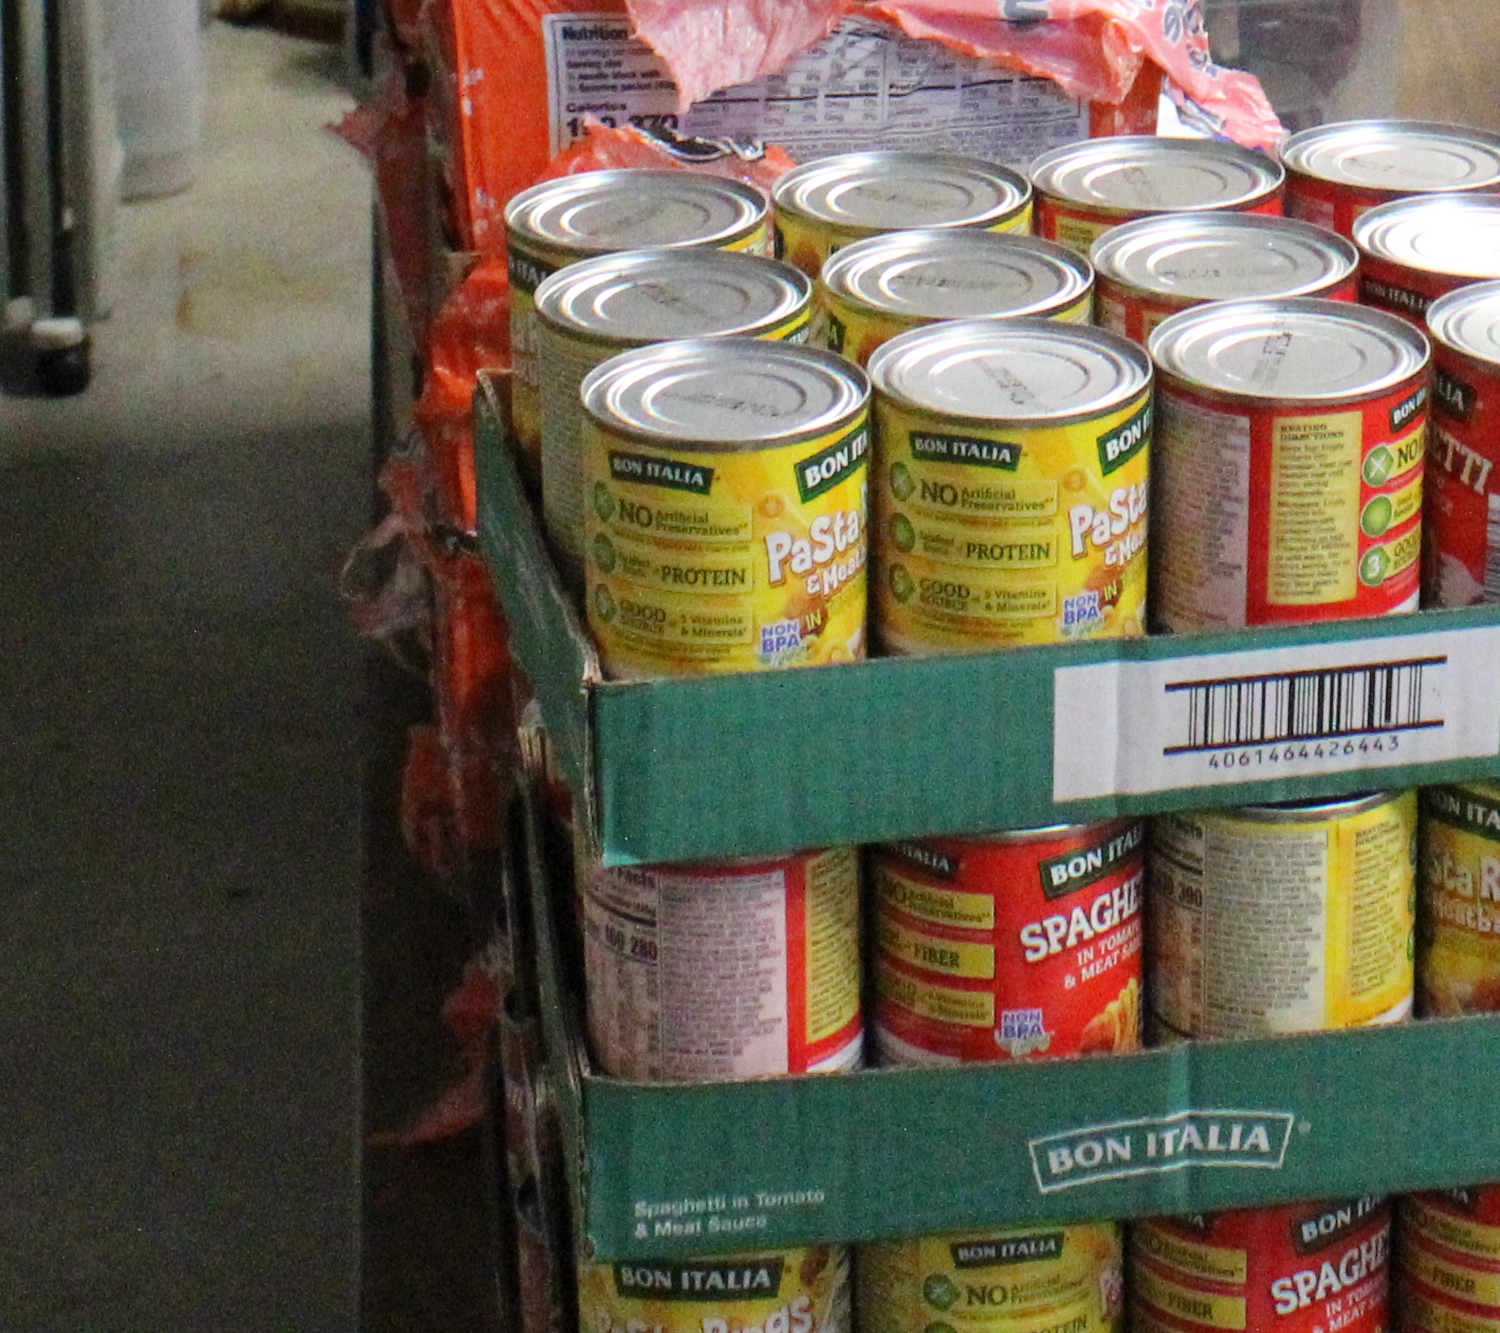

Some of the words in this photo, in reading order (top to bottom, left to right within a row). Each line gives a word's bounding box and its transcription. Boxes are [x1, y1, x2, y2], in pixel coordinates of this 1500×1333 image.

[562, 25, 629, 41] Nutrition
[566, 101, 628, 114] Calories
[914, 436, 950, 454] BON
[952, 441, 1013, 464] ITALIA
[1105, 424, 1142, 462] BON
[612, 455, 643, 475] BON
[645, 462, 706, 487] ITALIA
[803, 450, 850, 490] BON
[919, 479, 959, 507] NO
[961, 486, 1017, 500] Artificial
[617, 497, 654, 529] NO
[654, 509, 710, 524] Artificial
[960, 499, 1050, 512] Preservatives
[965, 541, 1052, 562] PROTEIN
[660, 565, 747, 587] PROTEIN
[919, 577, 971, 600] GOOD
[993, 588, 1048, 601] Vitamins
[1102, 582, 1119, 600] IN
[618, 599, 667, 624] GOOD
[1063, 594, 1099, 611] NON
[804, 608, 823, 631] IN
[1063, 607, 1100, 626] BPA
[761, 622, 799, 639] NON
[761, 635, 802, 655] BPA
[1207, 734, 1401, 770] 4061464426443
[1050, 846, 1103, 887] BON
[913, 942, 961, 970] FIBER
[1076, 943, 1095, 967] IN
[1063, 972, 1077, 990] &
[1080, 953, 1119, 983] MEAT
[1002, 1009, 1042, 1025] NON
[1001, 1022, 1043, 1039] BPA
[1047, 1135, 1133, 1175] BON
[1146, 1122, 1270, 1158] ITALIA
[634, 1193, 727, 1220] Spaghetti
[731, 1193, 750, 1210] in
[754, 1187, 825, 1209] Tomato
[634, 1221, 649, 1240] &
[653, 1218, 703, 1238] Meat
[707, 1214, 769, 1234] Sauce
[1301, 1207, 1351, 1244] BON
[957, 1245, 997, 1262] BON
[1001, 1238, 1057, 1258] ITALIA
[620, 1265, 673, 1288] BON
[680, 1267, 772, 1291] ITALIA
[966, 1285, 1009, 1307] NO
[1168, 1292, 1214, 1321] FIBER
[1325, 1296, 1343, 1317] IN
